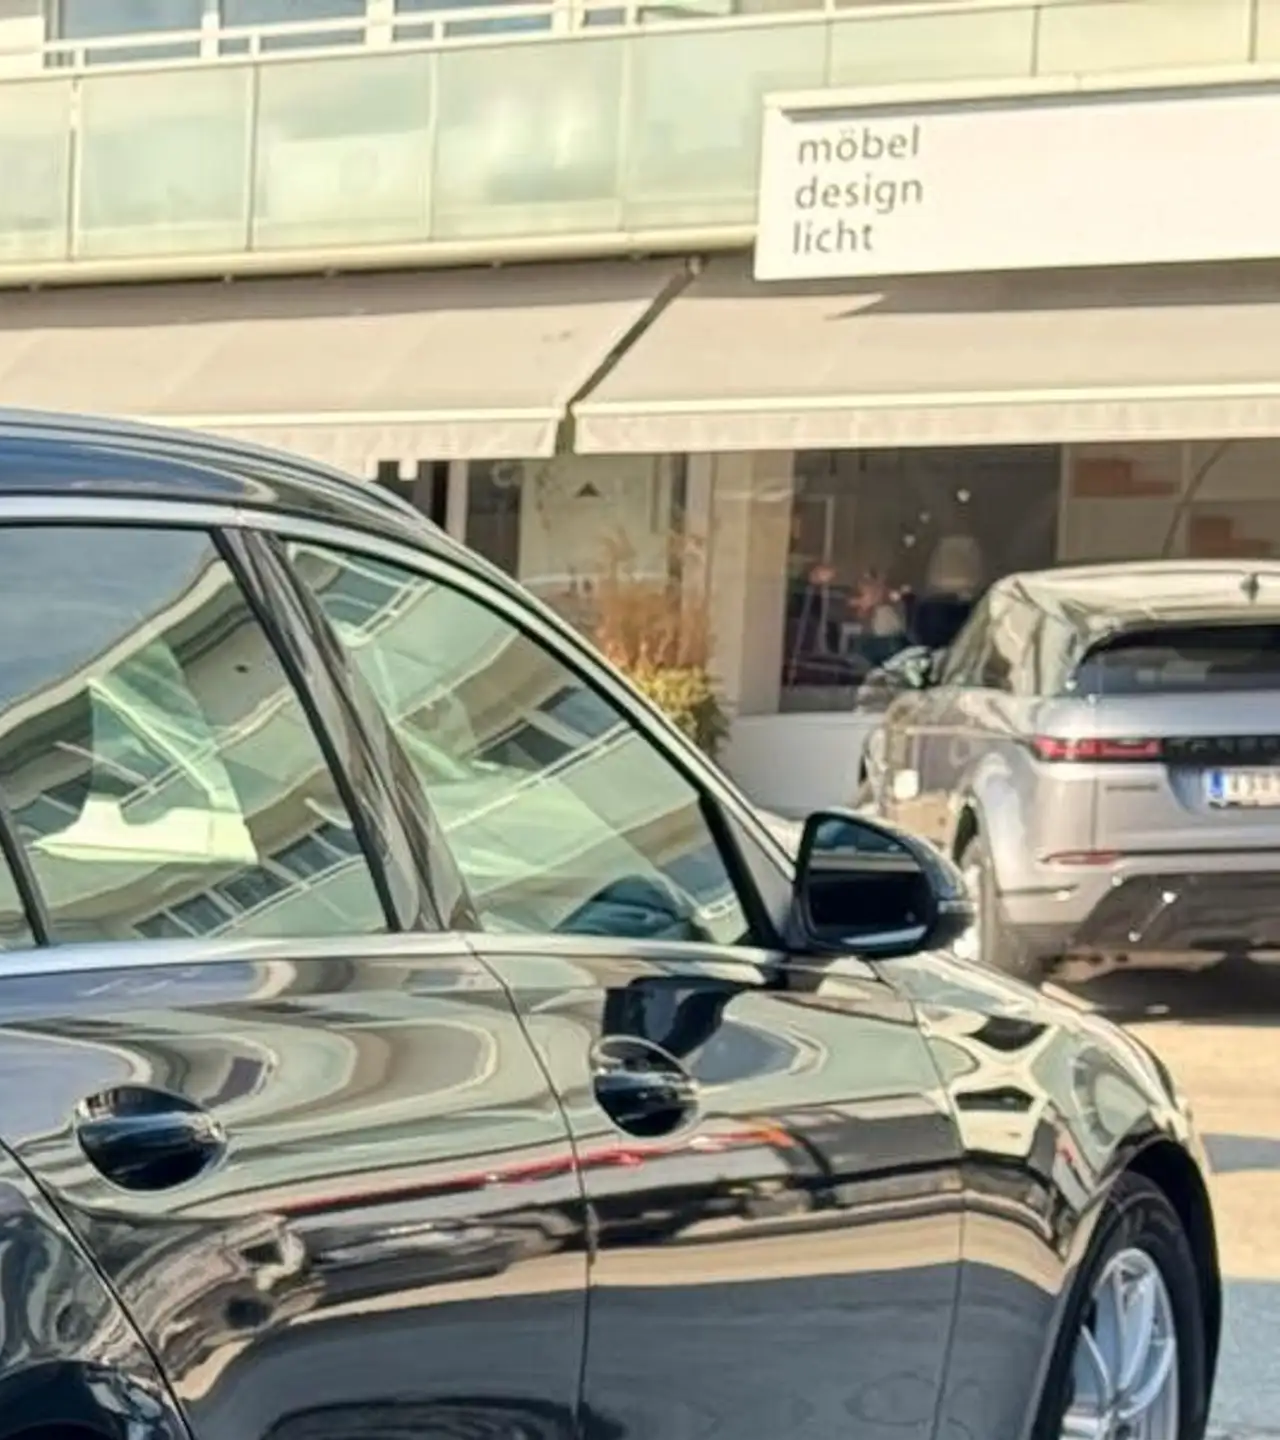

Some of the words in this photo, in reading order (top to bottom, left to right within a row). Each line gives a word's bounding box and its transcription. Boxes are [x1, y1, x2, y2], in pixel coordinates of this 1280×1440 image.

[797, 123, 921, 164] möbel
[795, 172, 924, 215] design
[792, 219, 874, 254] licht
